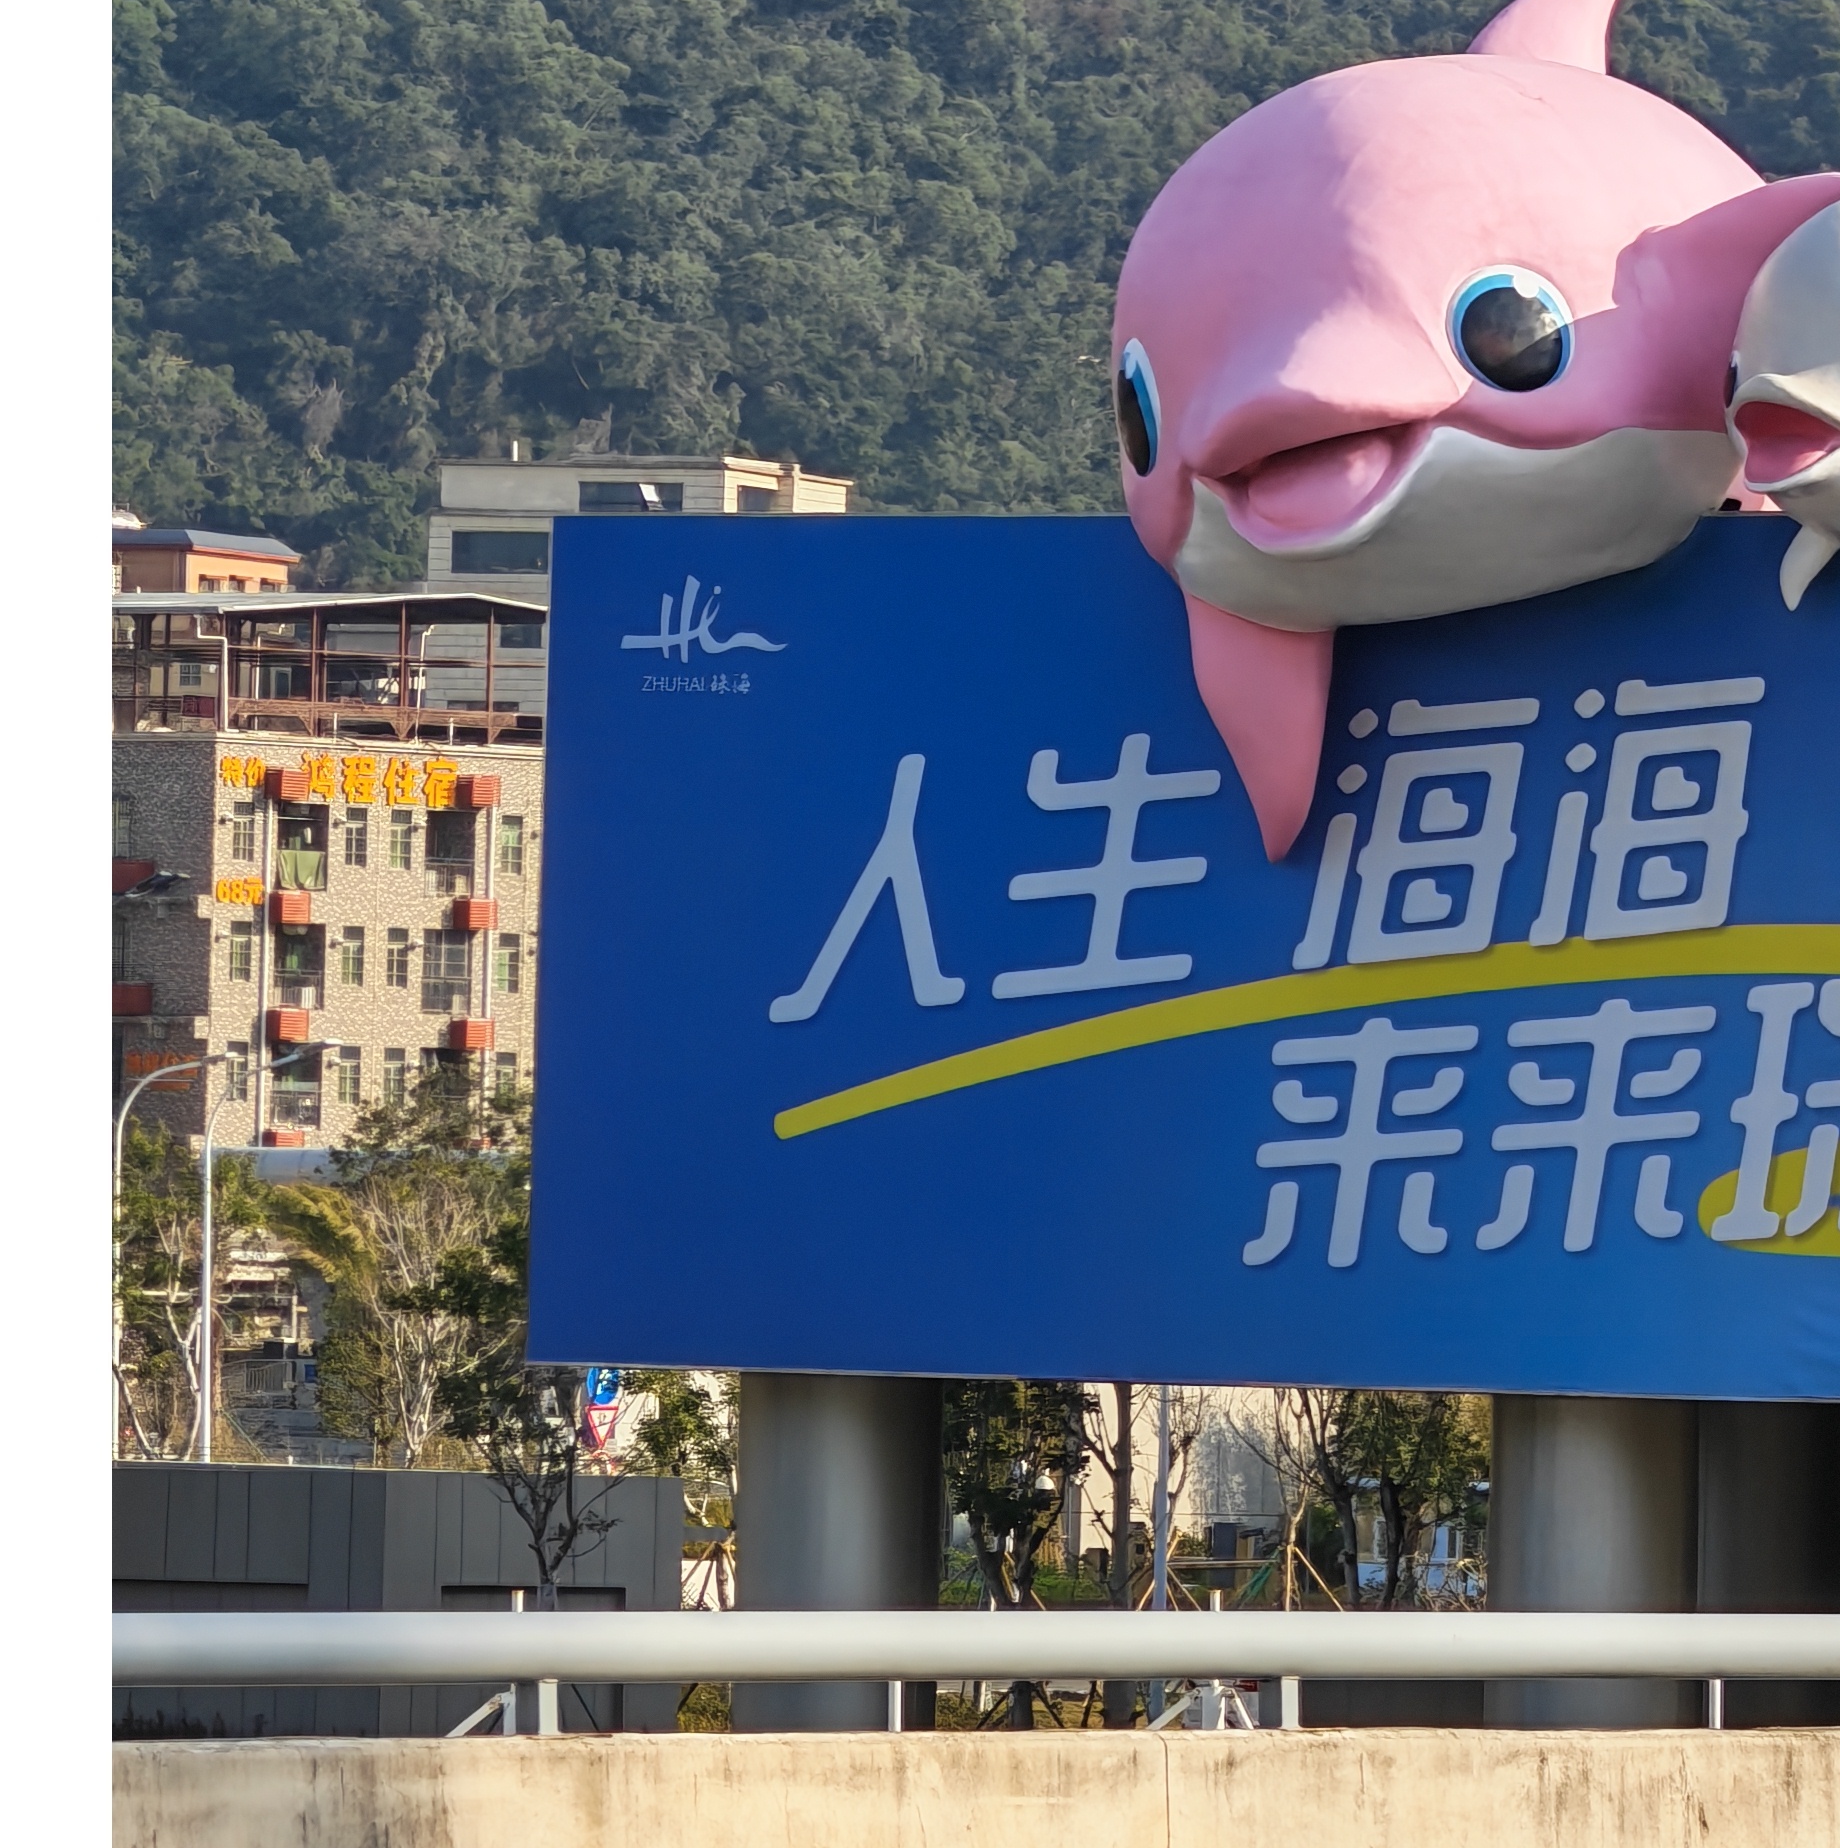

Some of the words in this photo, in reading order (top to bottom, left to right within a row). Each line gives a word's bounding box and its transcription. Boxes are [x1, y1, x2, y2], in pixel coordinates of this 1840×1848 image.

[642, 676, 704, 691] ZHUHAI
[221, 756, 264, 787] 特价
[216, 878, 263, 905] 68元
